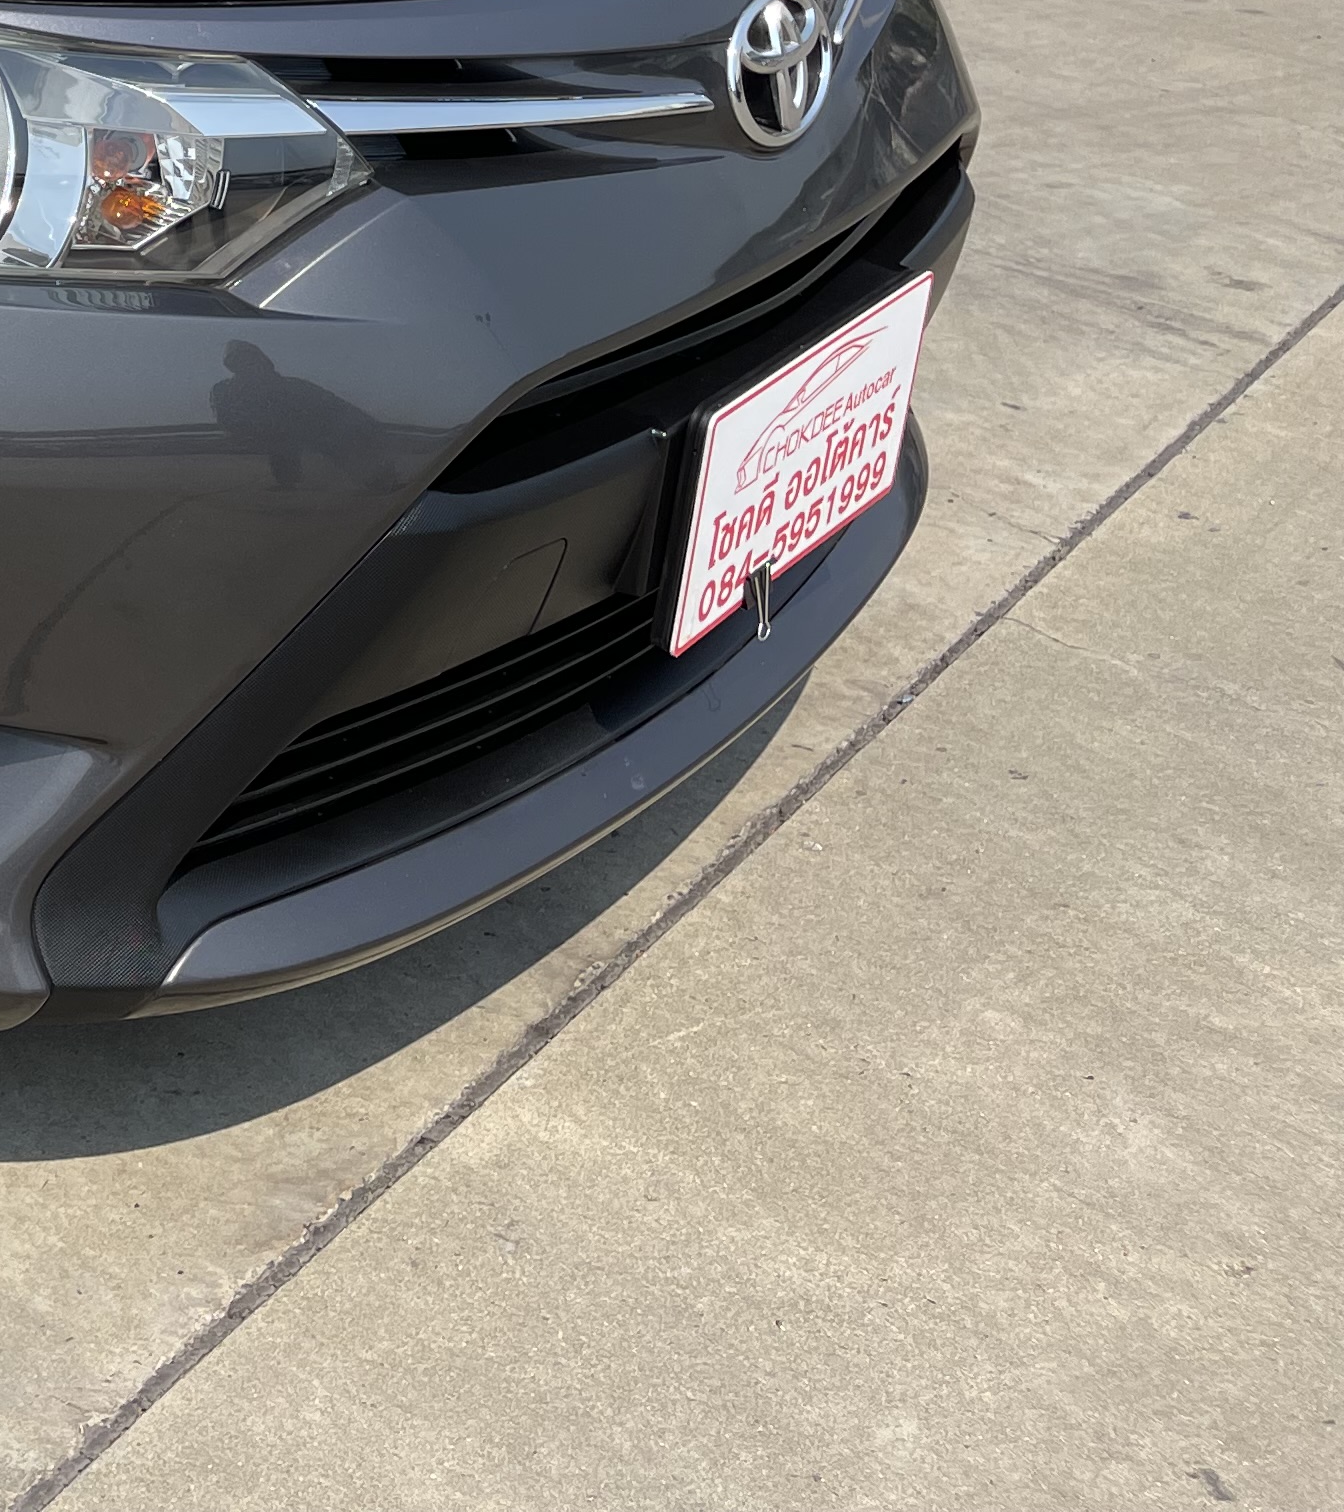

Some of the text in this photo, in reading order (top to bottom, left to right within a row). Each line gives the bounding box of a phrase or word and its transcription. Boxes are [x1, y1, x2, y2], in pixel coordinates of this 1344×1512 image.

[762, 366, 897, 473] CHOKDEE Autocar
[698, 451, 887, 622] 084-5951999
[708, 471, 779, 570] โชคดี
